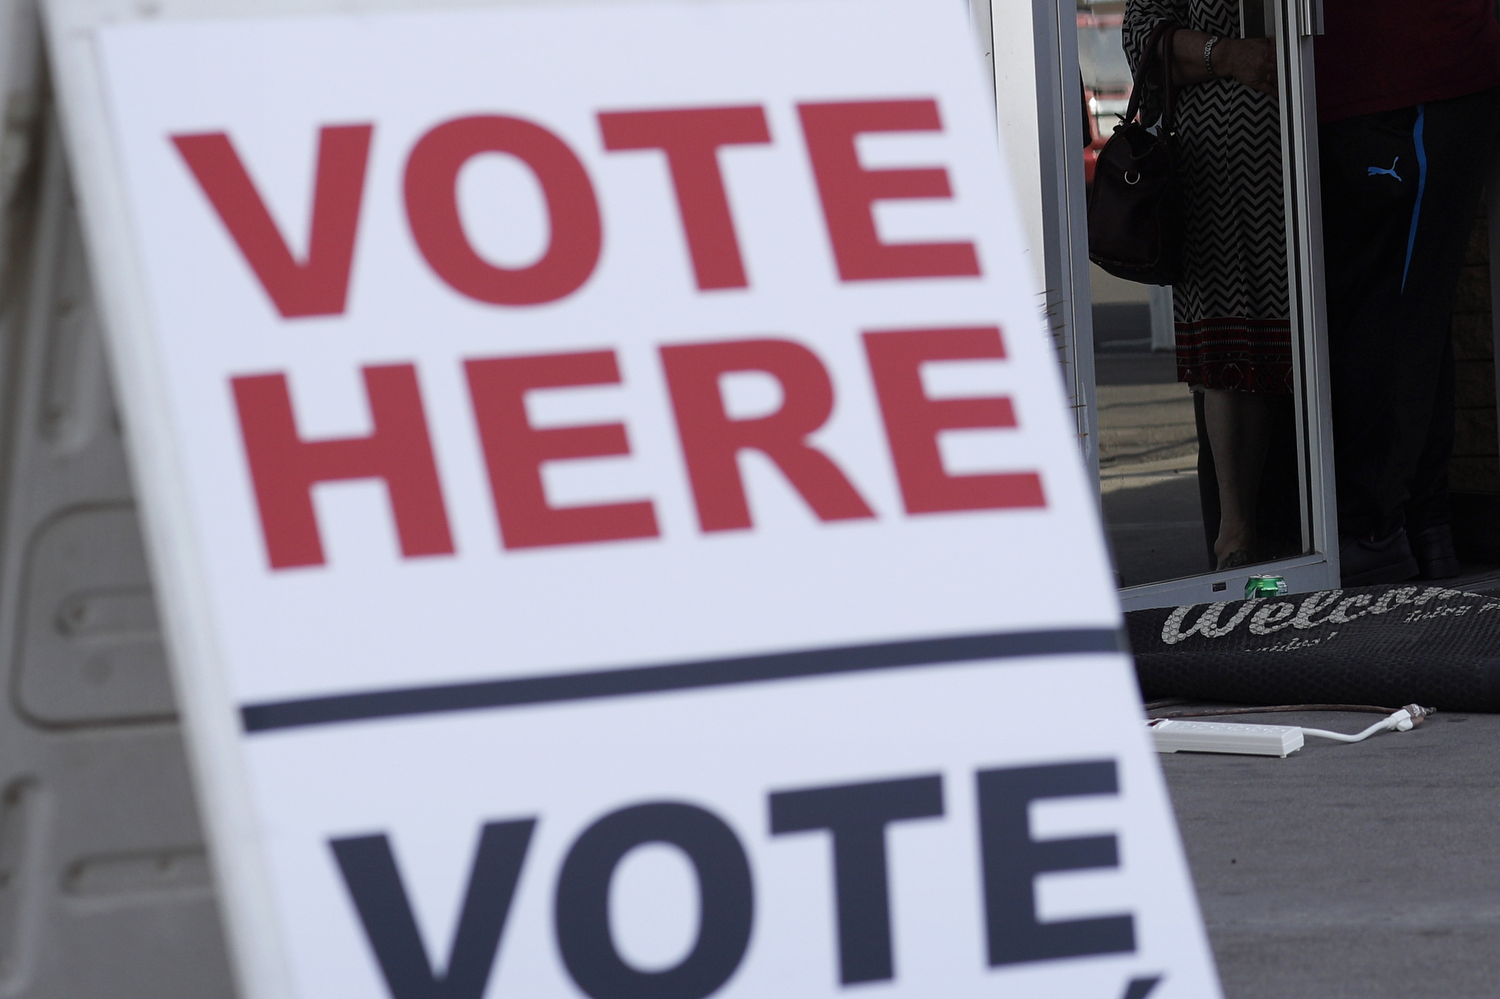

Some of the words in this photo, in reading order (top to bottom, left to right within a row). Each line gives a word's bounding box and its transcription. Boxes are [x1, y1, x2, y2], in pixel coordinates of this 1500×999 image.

[172, 98, 982, 320] VOTE
[230, 327, 1048, 571] HERE
[326, 759, 1138, 999] VOTE
